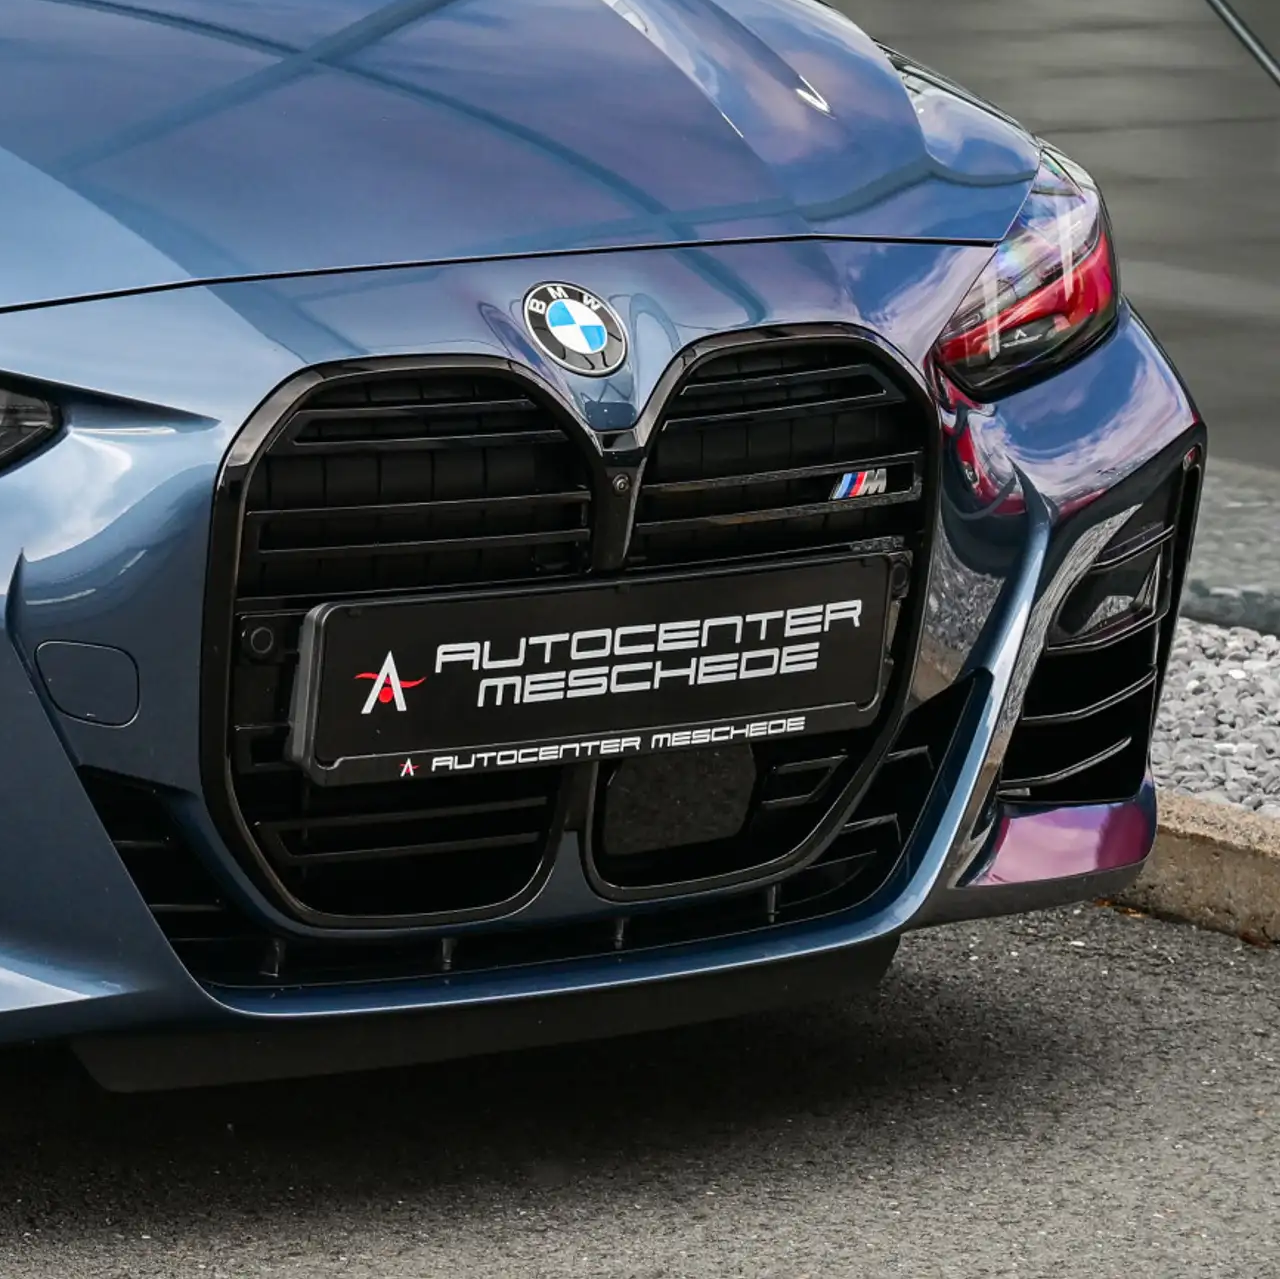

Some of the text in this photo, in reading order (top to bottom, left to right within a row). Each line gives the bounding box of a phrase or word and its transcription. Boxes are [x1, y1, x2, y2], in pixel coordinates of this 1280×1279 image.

[528, 285, 603, 315] BMW
[434, 599, 863, 674] AUTOCENTER
[477, 641, 821, 708] MESCHEDE
[430, 735, 641, 772] AUTOCENTER
[650, 716, 807, 749] MESCHEDE
